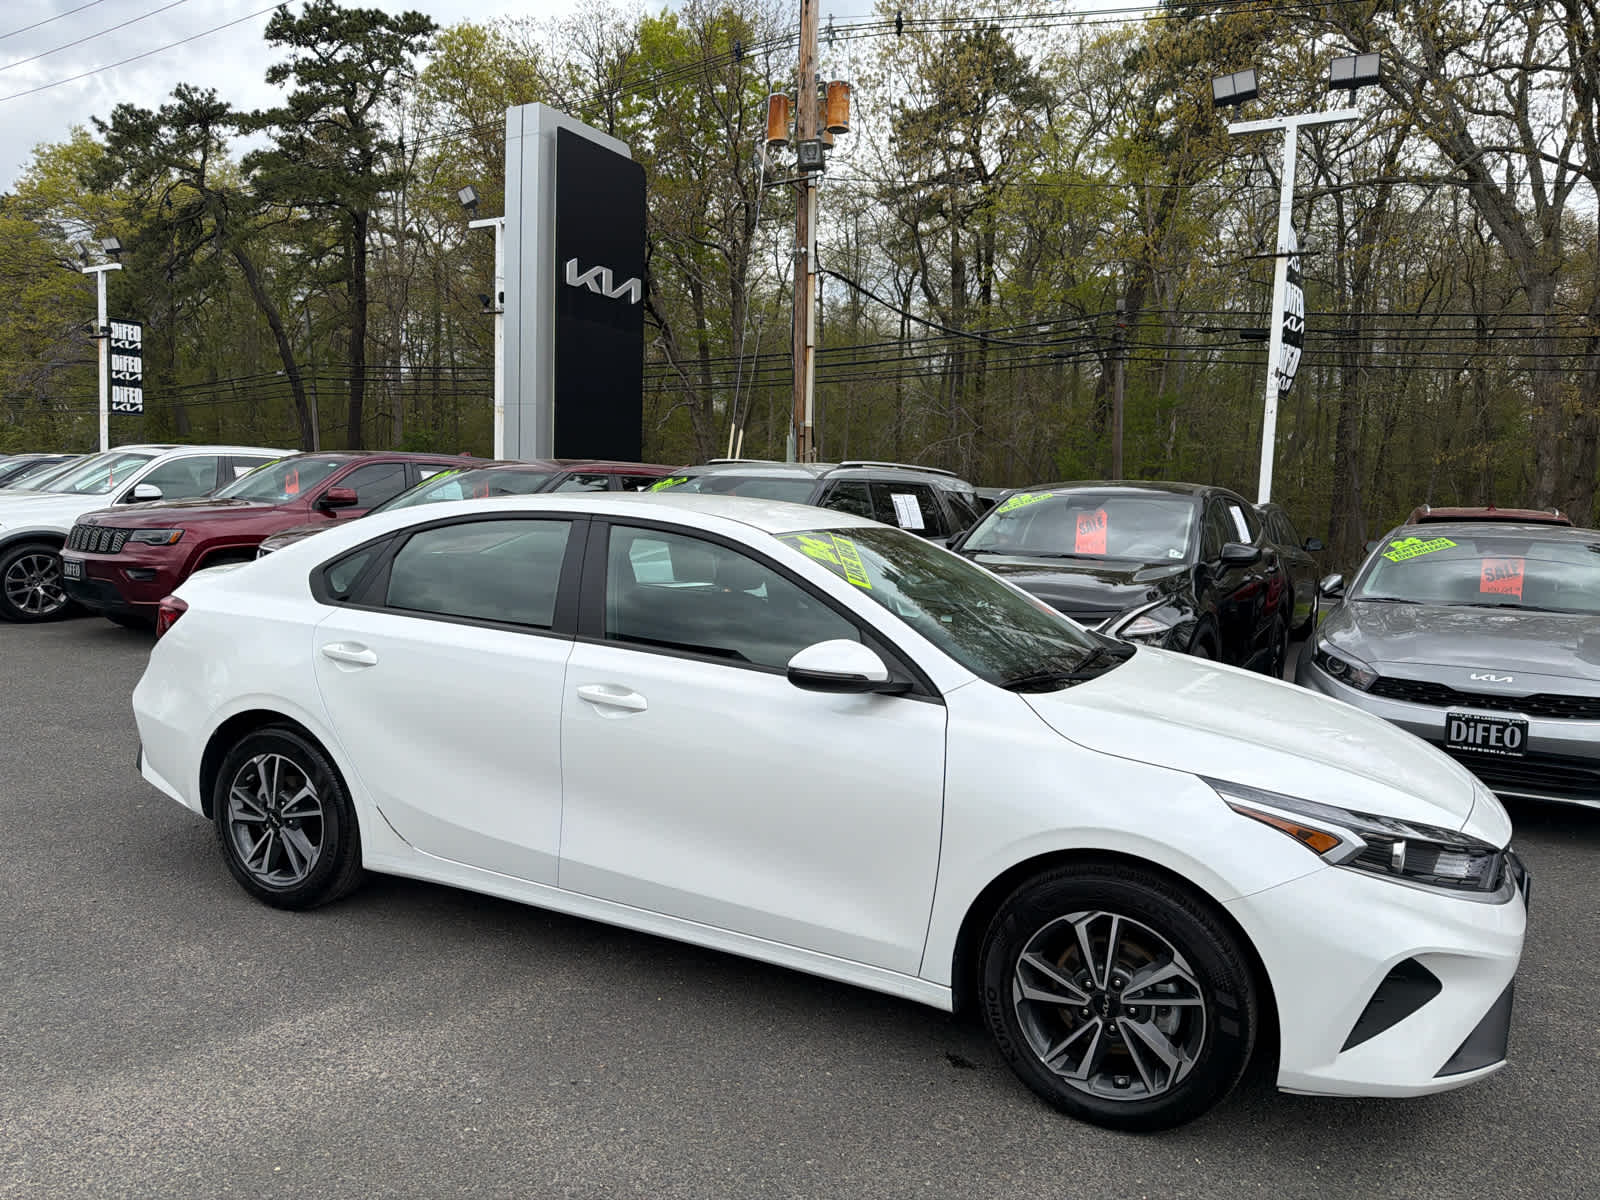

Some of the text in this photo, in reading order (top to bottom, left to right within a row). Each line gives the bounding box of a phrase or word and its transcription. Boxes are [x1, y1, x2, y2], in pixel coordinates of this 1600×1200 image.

[566, 258, 641, 304] KIA
[111, 339, 142, 350] KIA
[112, 371, 142, 380] KIA
[112, 402, 143, 412] KIA
[1079, 516, 1104, 535] SALE
[1484, 560, 1520, 582] SALE
[1470, 673, 1514, 683] KIA
[1450, 720, 1522, 748] DiFEO
